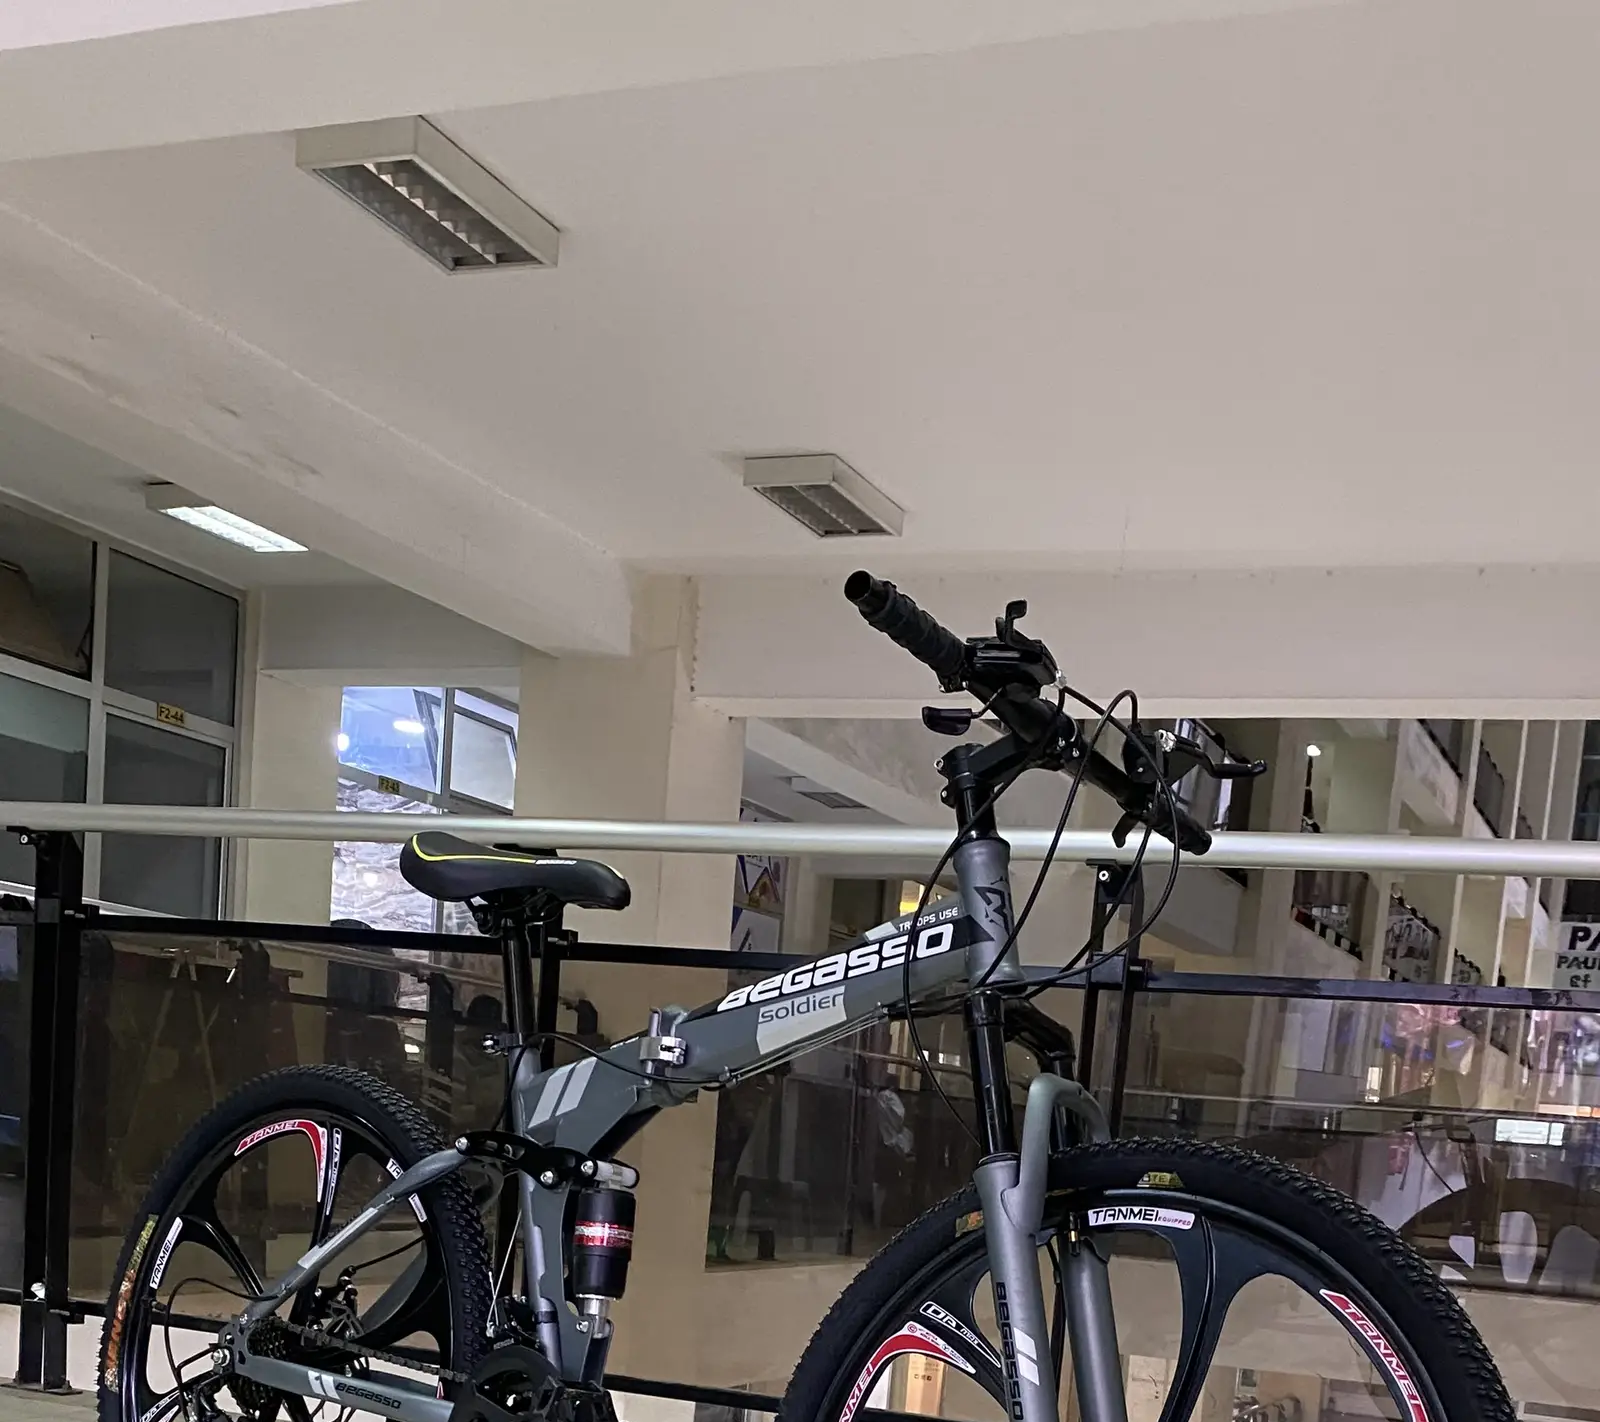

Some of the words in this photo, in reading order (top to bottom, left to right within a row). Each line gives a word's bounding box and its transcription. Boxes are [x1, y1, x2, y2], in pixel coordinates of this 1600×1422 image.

[160, 706, 185, 724] F2-44
[938, 906, 959, 920] USE
[760, 993, 844, 1024] soldier
[1093, 1207, 1159, 1223] TANMEI
[1158, 1216, 1192, 1226] EQUIPPED
[151, 1240, 172, 1286] TANMEI
[1343, 1303, 1420, 1405] TANMEI
